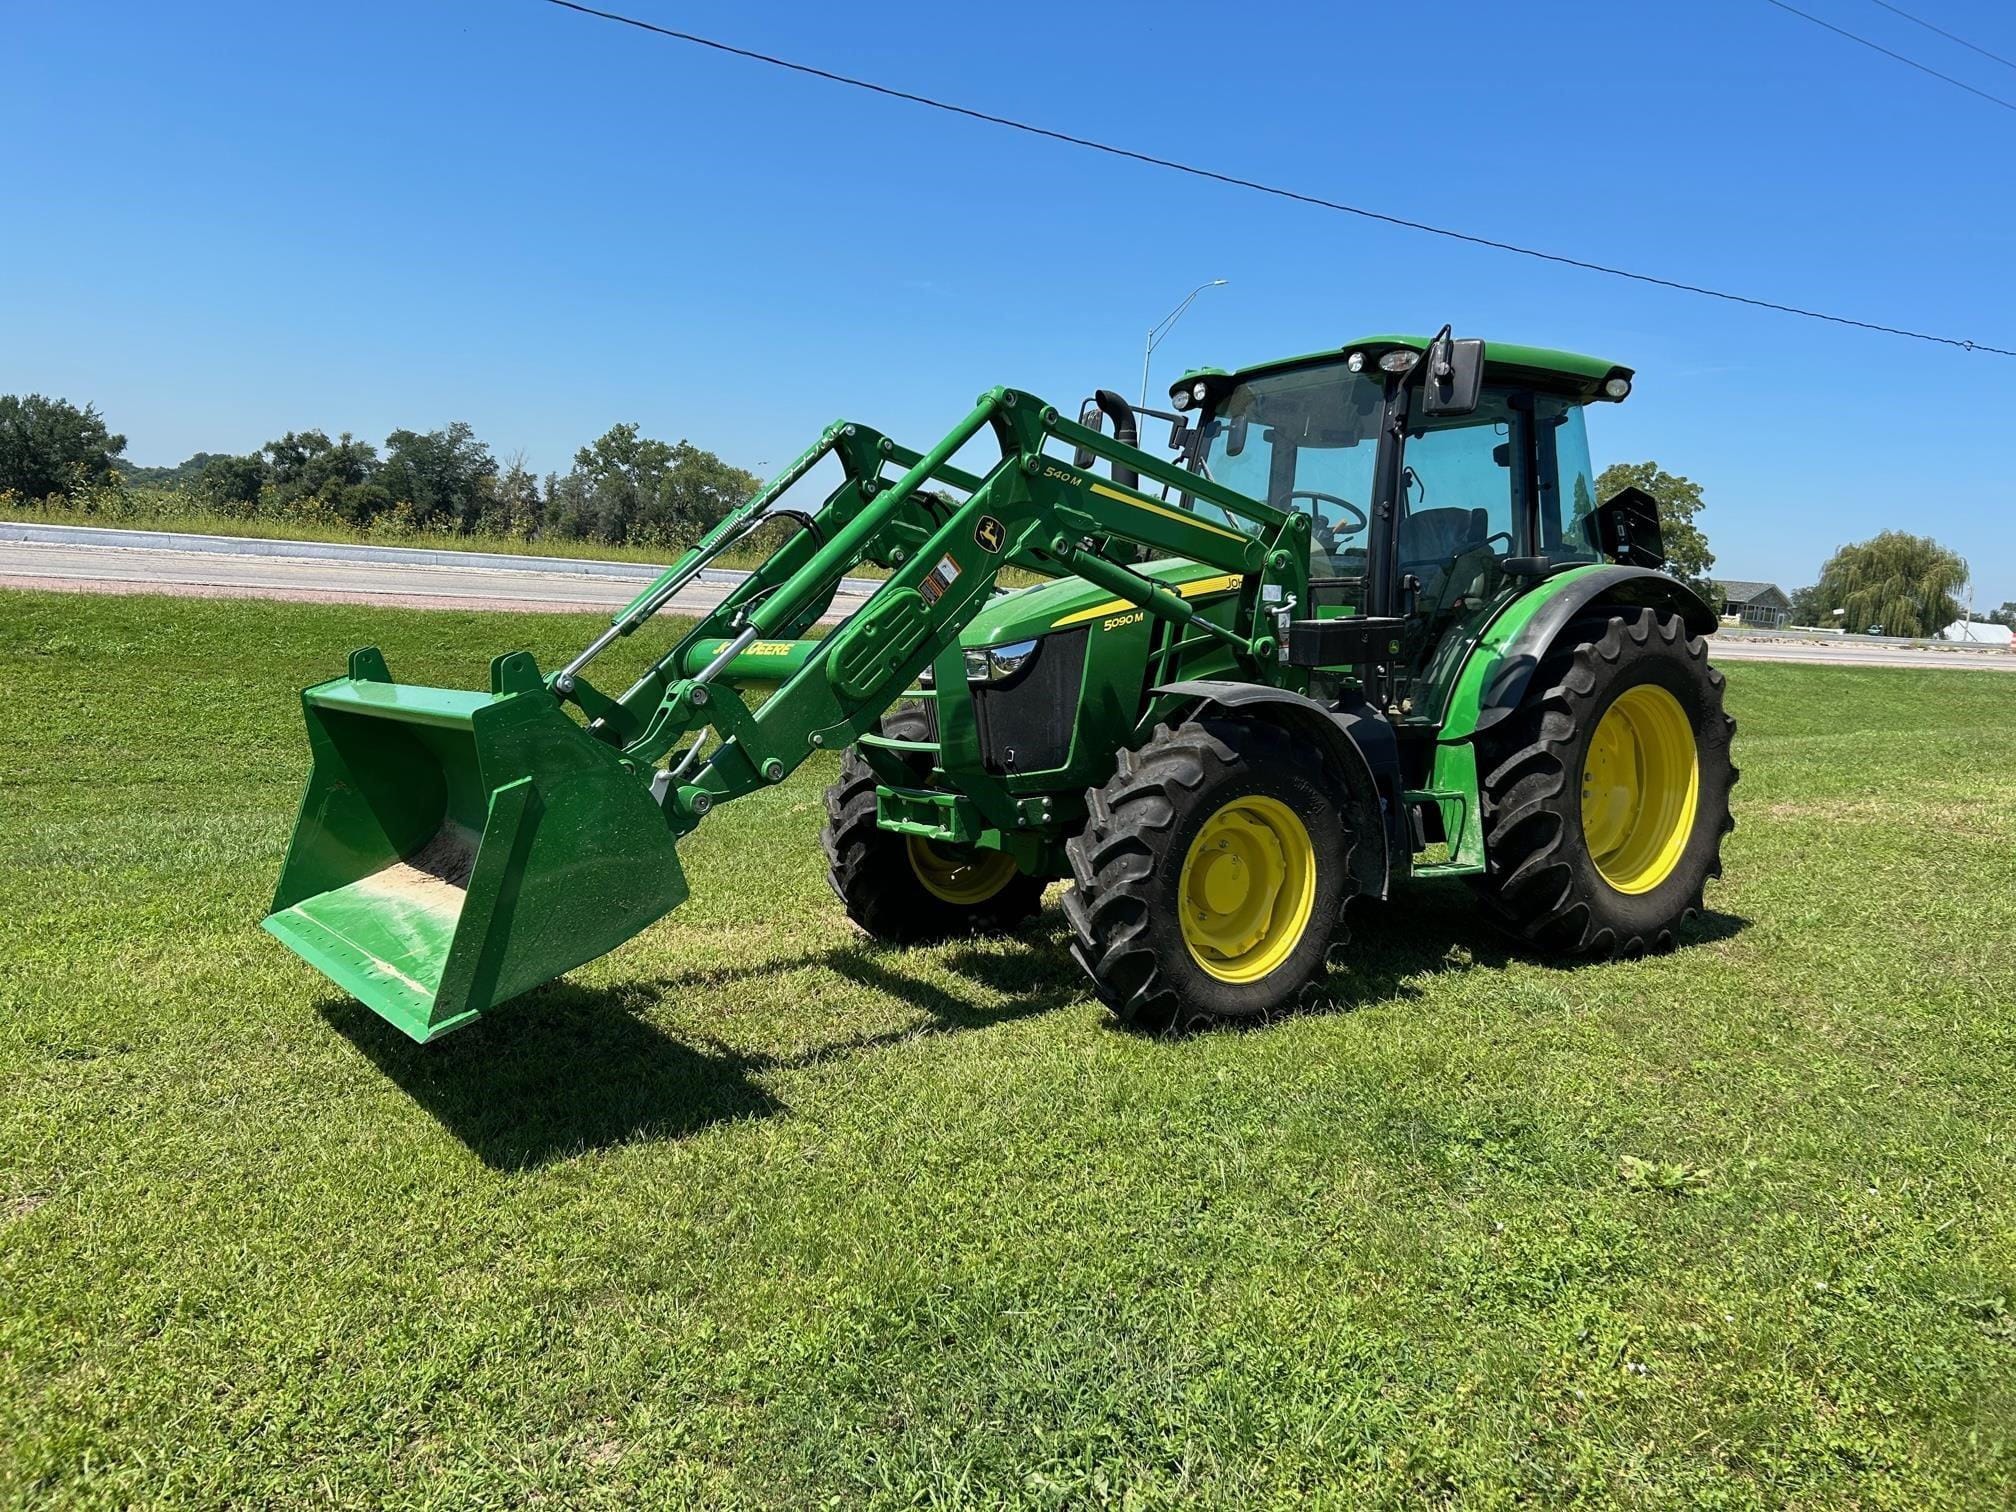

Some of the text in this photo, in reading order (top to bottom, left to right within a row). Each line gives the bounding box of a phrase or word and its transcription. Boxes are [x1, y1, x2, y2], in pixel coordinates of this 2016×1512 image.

[1043, 466, 1082, 487] 540 M
[1226, 577, 1243, 589] JOH
[1104, 612, 1144, 631] 5090 M
[746, 641, 796, 656] DEERE
